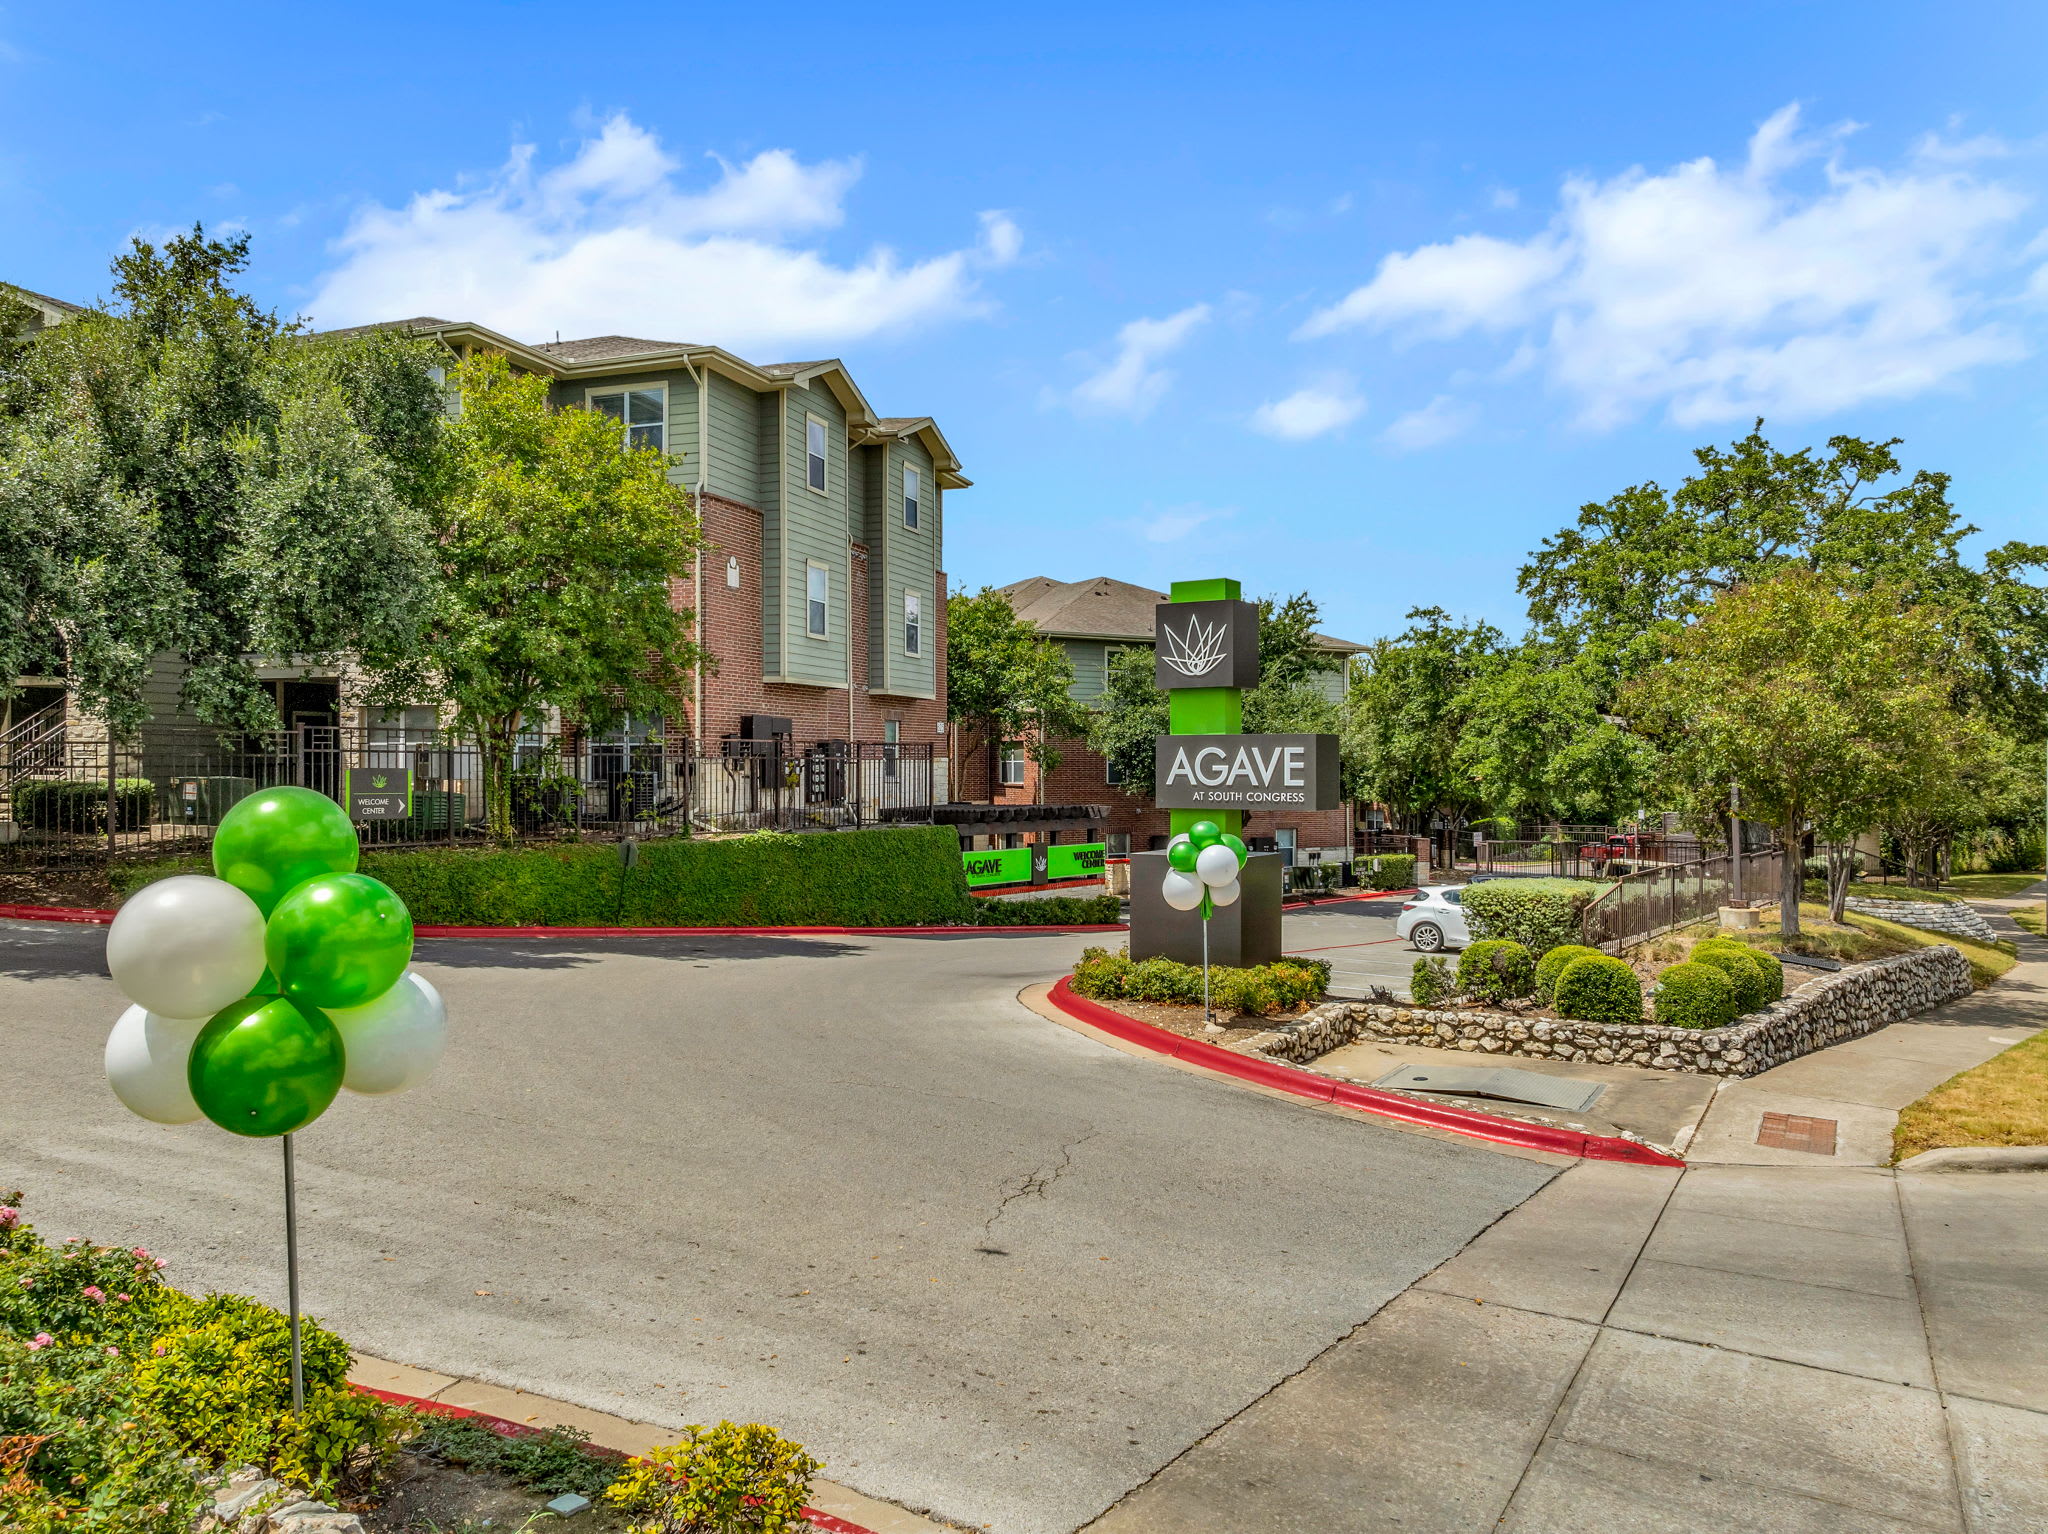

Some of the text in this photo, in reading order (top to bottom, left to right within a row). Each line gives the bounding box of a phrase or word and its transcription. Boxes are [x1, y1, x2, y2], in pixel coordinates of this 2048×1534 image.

[1165, 745, 1305, 788] AGAVE
[357, 798, 390, 806] WELCOME
[1192, 791, 1305, 803] AT SOUTH CONGRESS
[362, 807, 385, 815] CENTER
[966, 858, 1002, 875] AGAVE
